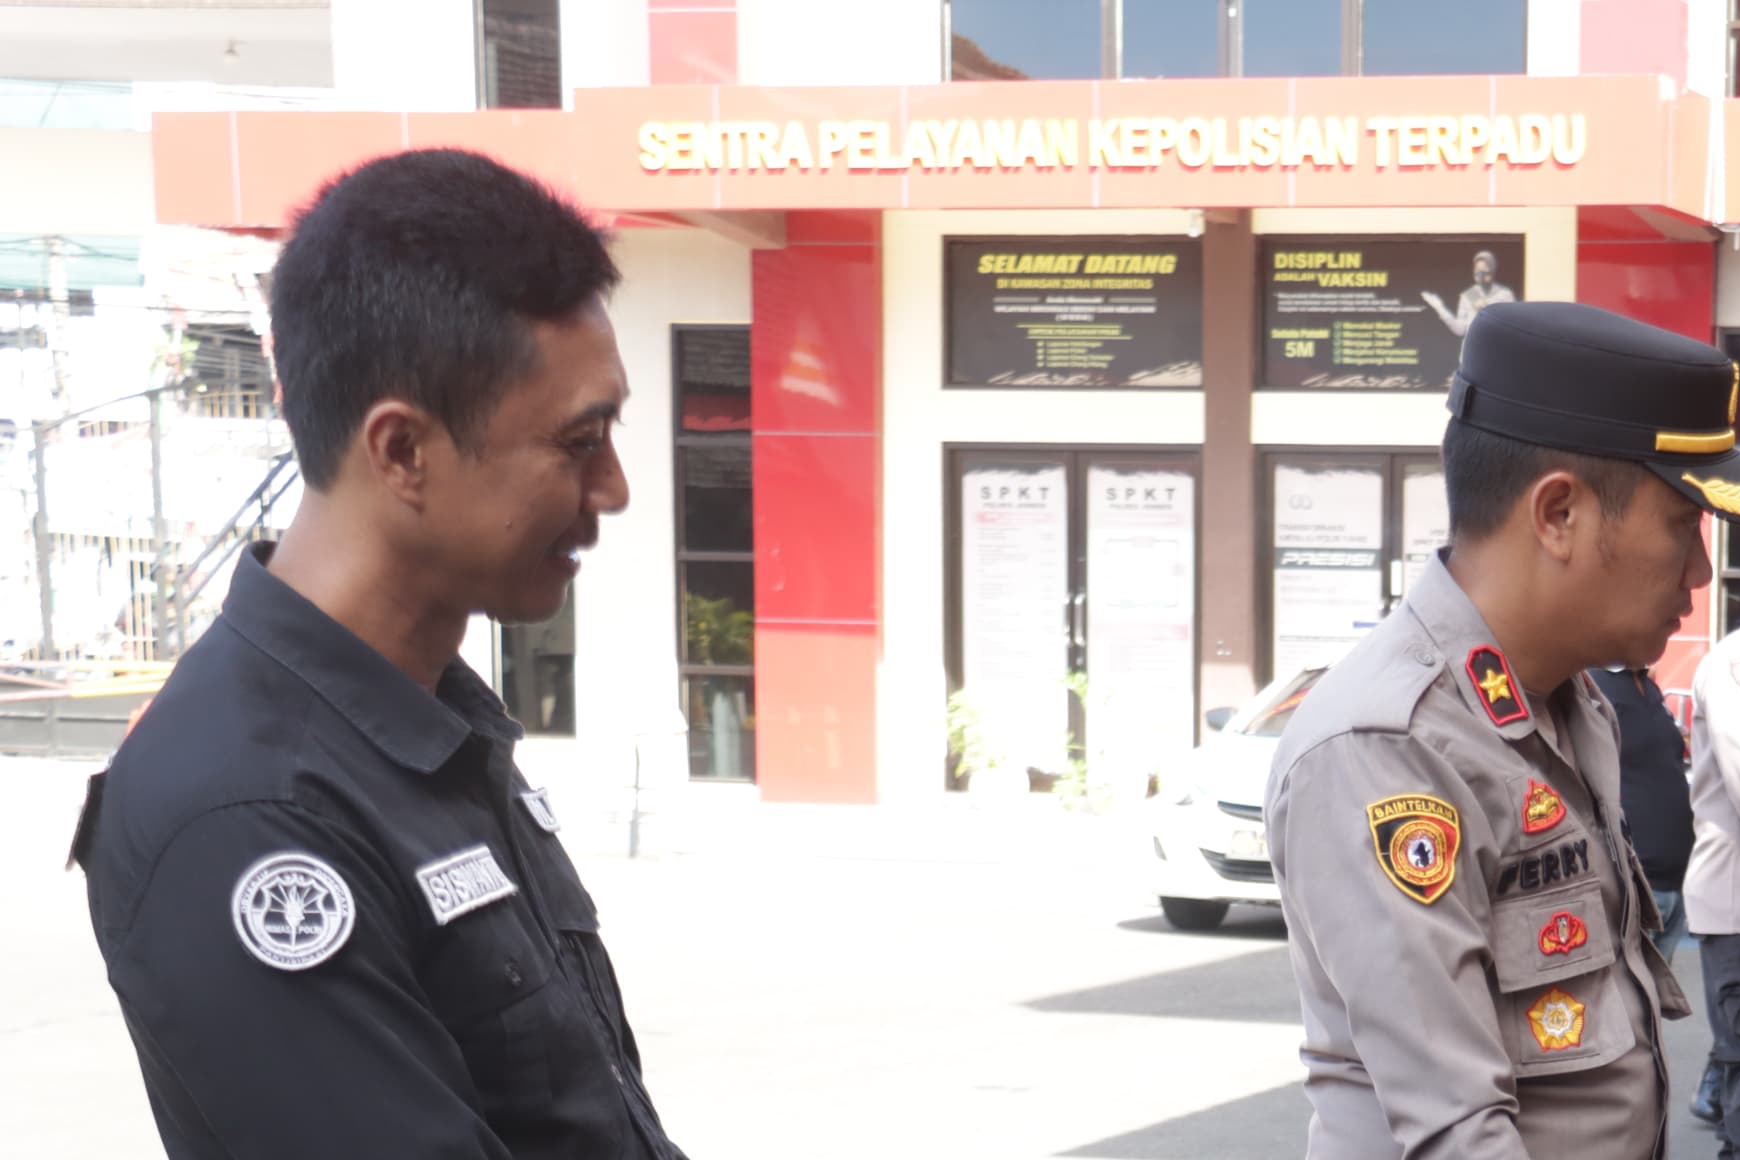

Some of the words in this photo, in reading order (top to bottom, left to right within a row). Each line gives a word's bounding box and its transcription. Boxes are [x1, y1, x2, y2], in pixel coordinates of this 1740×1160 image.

[638, 120, 811, 172] SENTRA
[818, 119, 1078, 172] PELAYANAN
[1088, 117, 1358, 170] KEPOLISIAN
[1366, 115, 1587, 168] TERPADU
[977, 255, 1084, 274] SELAMAT
[1084, 255, 1178, 274] DATANG
[1274, 253, 1362, 269] DISIPLIN
[1318, 272, 1389, 287] VAKSIN
[1285, 341, 1315, 357] 5M
